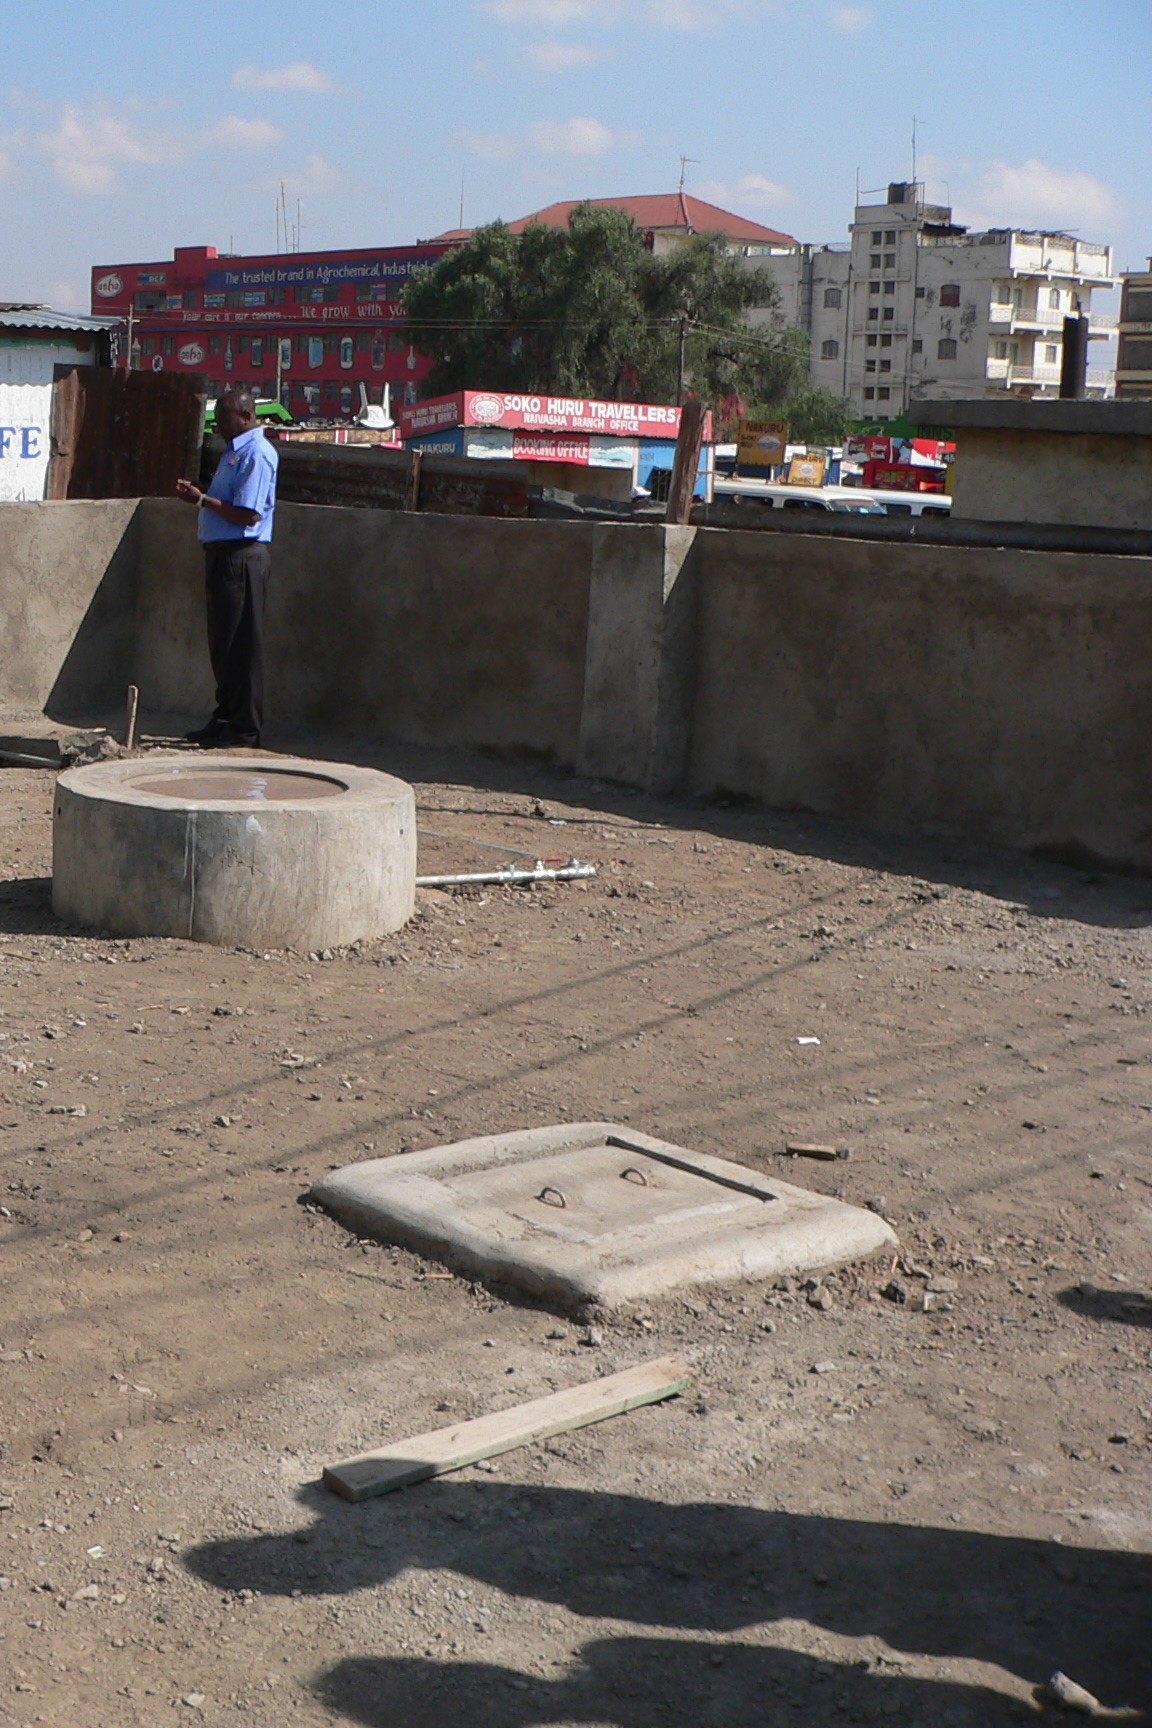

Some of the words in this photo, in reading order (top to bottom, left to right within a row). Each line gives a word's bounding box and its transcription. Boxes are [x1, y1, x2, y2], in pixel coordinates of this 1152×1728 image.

[225, 272, 239, 284] The
[243, 269, 276, 283] trusted
[277, 267, 305, 281] brand
[306, 267, 315, 280] in
[300, 305, 318, 319] We
[322, 306, 351, 322] grow
[358, 303, 382, 318] with
[504, 395, 541, 413] SOKO
[548, 399, 584, 416] HURU
[589, 402, 676, 424] TRAVELLERS
[523, 413, 567, 427] NAIVASHA
[572, 417, 605, 430] BRANCH
[610, 420, 639, 432] OFFICE
[745, 422, 784, 434] NAKURU
[419, 442, 456, 455] NAKURU
[513, 437, 556, 457] BOOKING
[557, 440, 588, 459] OFFICE
